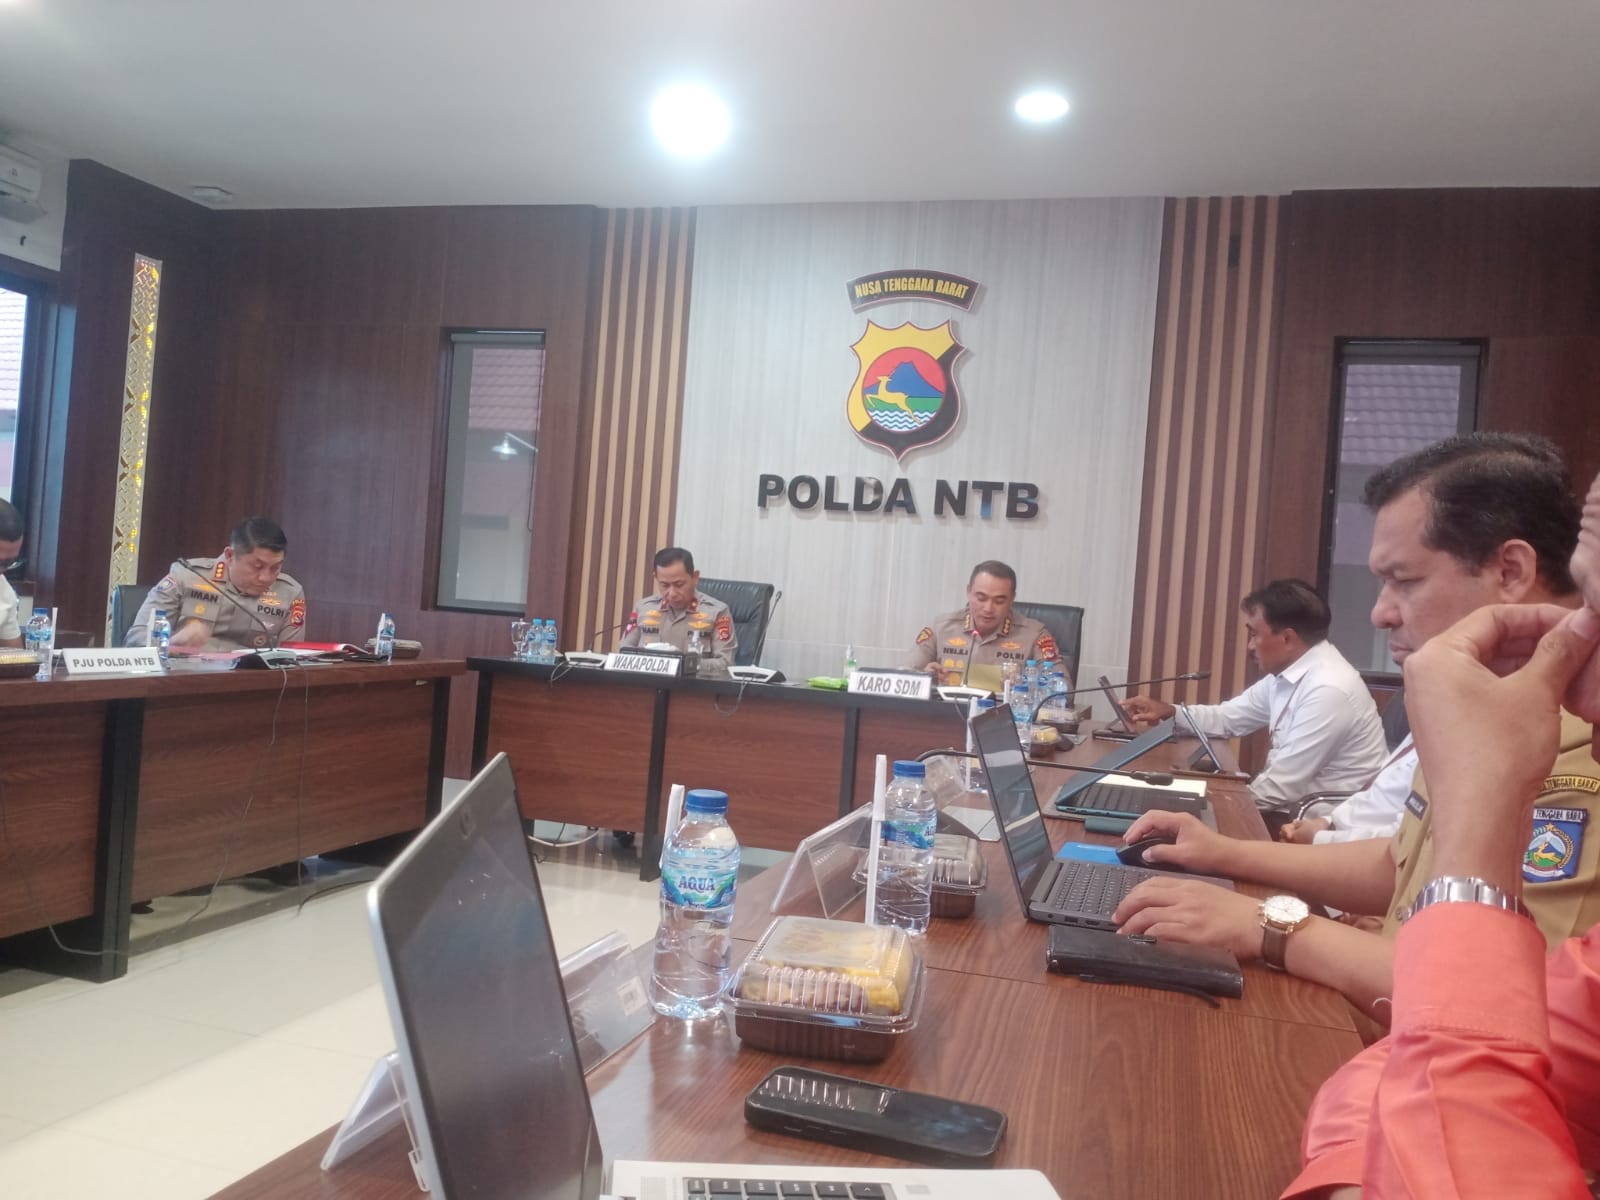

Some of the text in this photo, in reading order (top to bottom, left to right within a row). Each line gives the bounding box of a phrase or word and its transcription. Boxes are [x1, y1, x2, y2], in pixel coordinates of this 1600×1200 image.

[854, 277, 969, 299] NUSA TENGGARA BARAT
[757, 473, 1040, 520] POLDA NTB
[190, 590, 219, 604] IMAN
[256, 604, 285, 618] POLRI
[72, 657, 155, 668] PJU POLDA NTB
[613, 654, 671, 674] WAKAPOLDA
[996, 651, 1025, 661] POLRI
[857, 675, 923, 697] KARO SDM
[678, 875, 716, 893] AQUA
